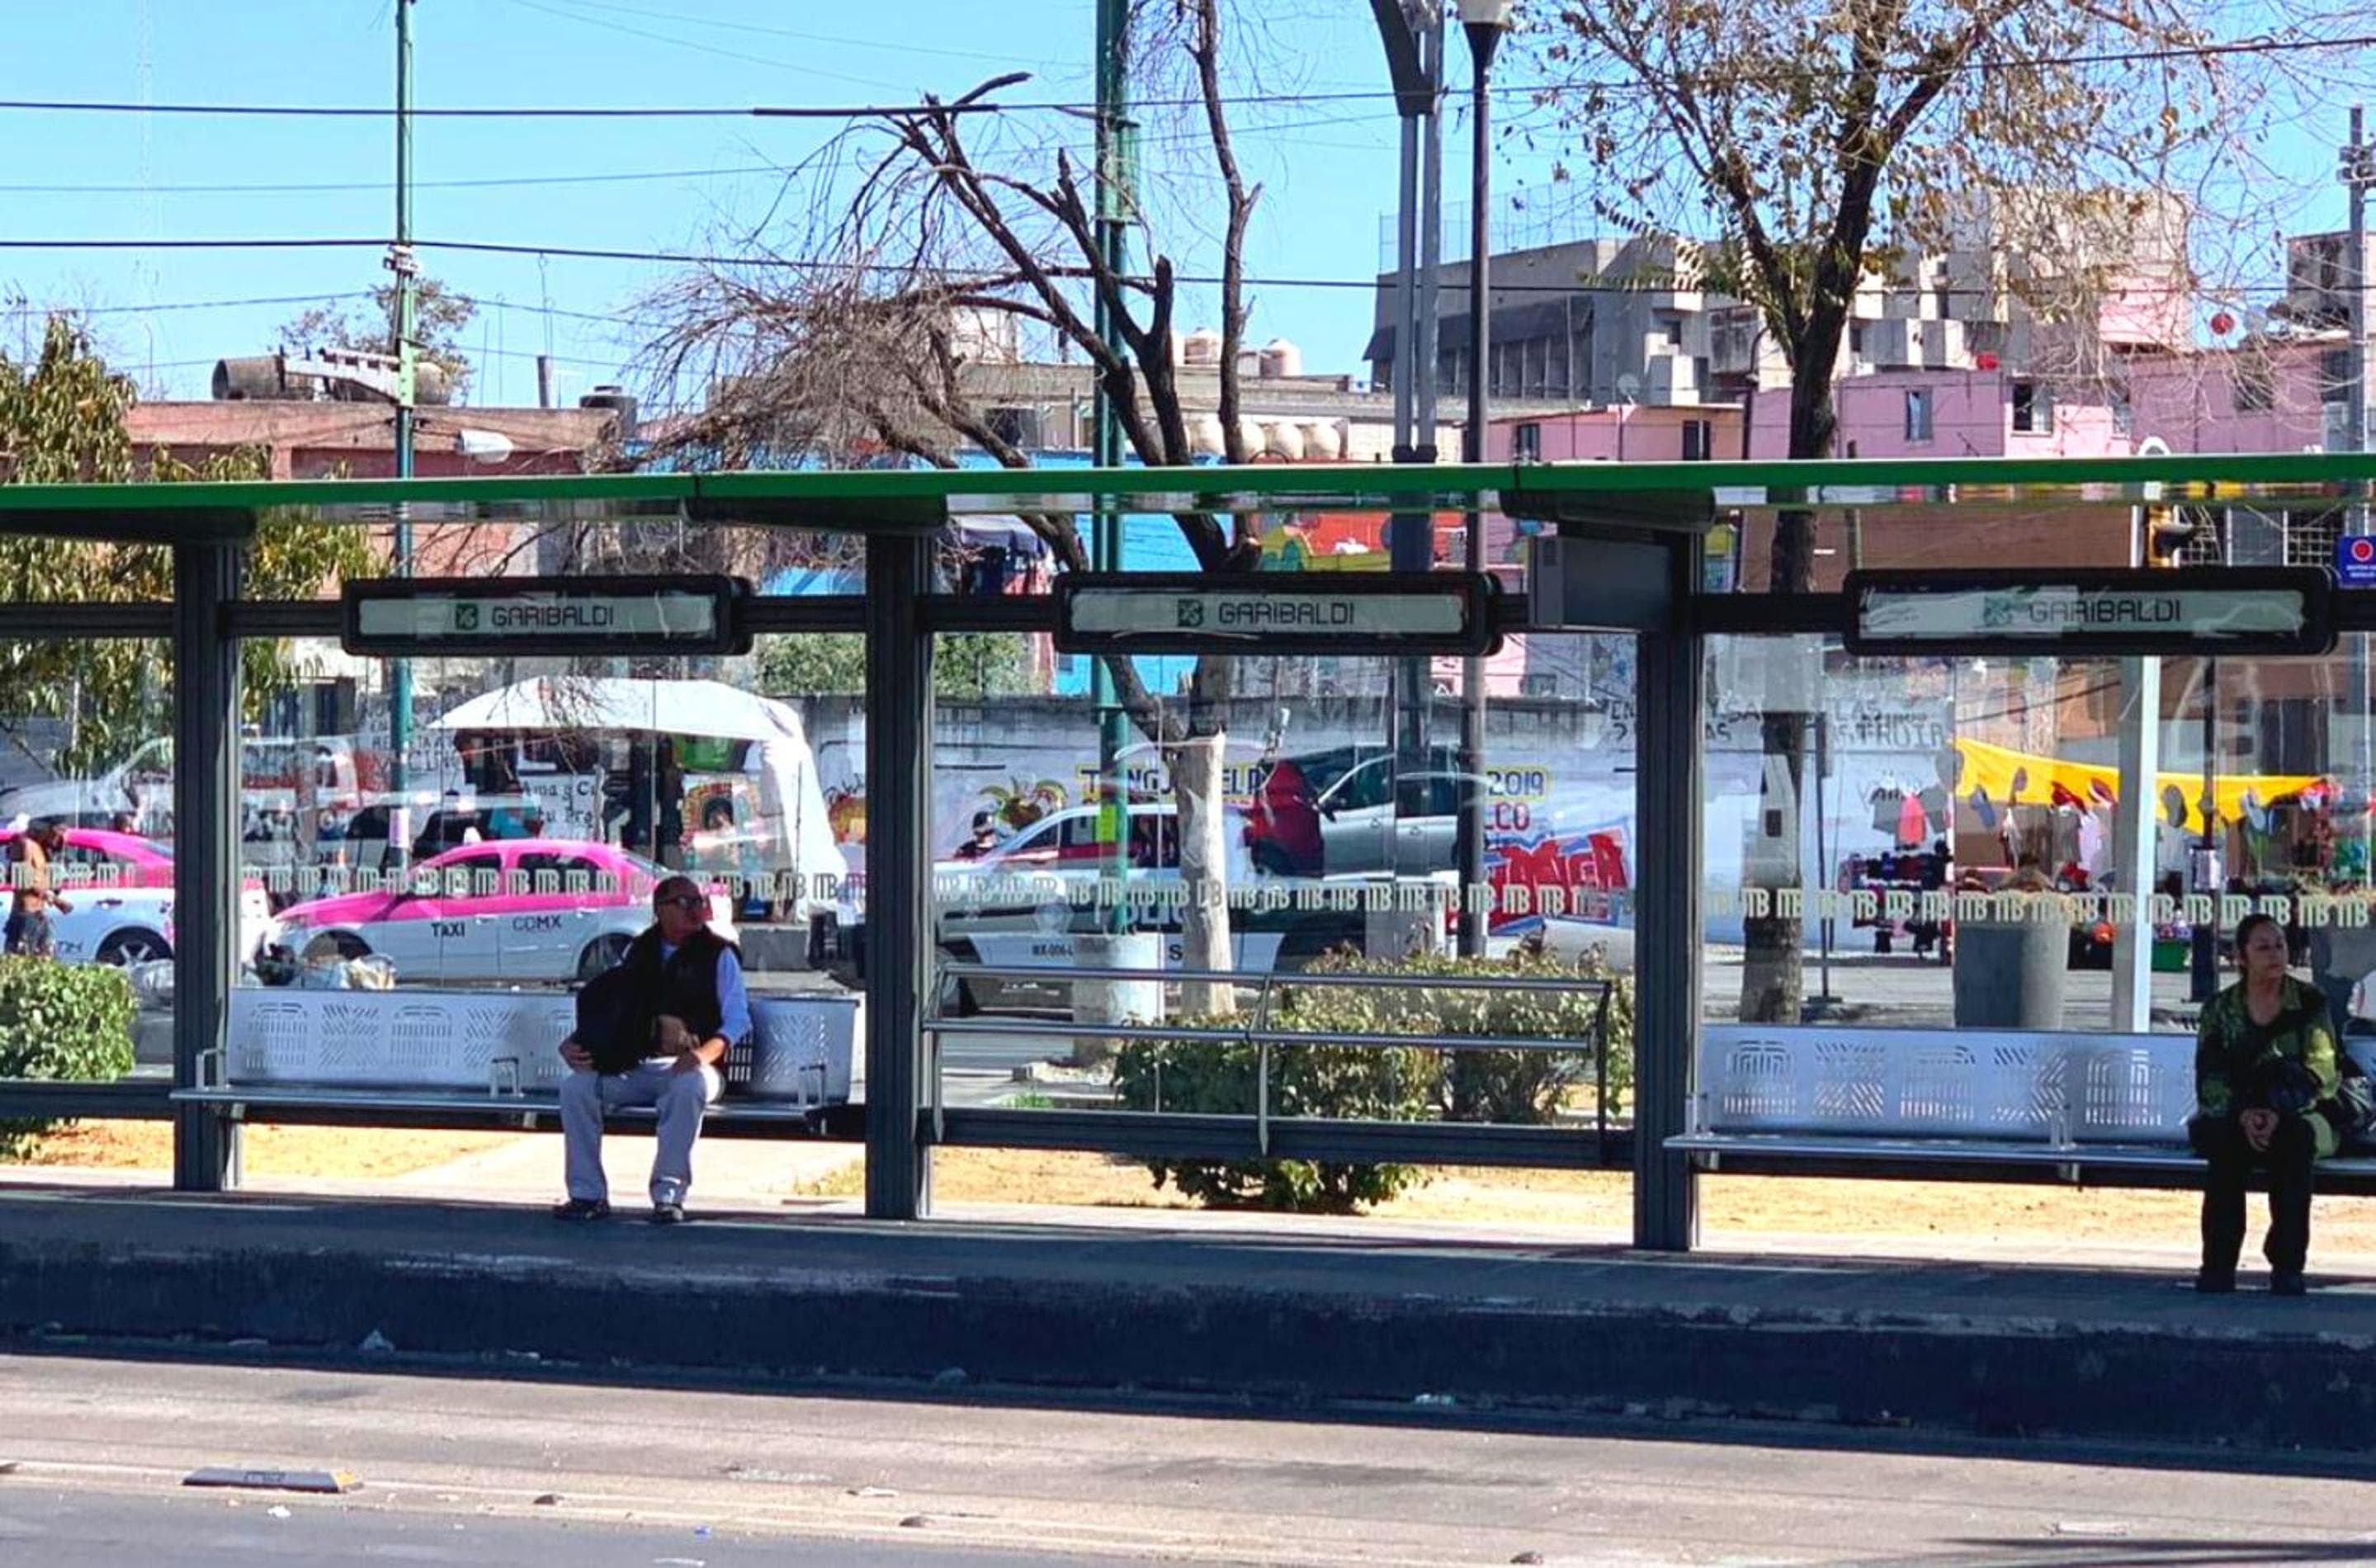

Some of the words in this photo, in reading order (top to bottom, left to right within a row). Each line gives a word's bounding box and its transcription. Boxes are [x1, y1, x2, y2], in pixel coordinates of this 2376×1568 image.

[491, 606, 614, 627] GARIBALDI
[1218, 602, 1353, 625] GARIBALDI
[2028, 599, 2180, 622] GARIBALDI
[1486, 769, 1544, 796] 2019
[432, 922, 465, 937] TAXI
